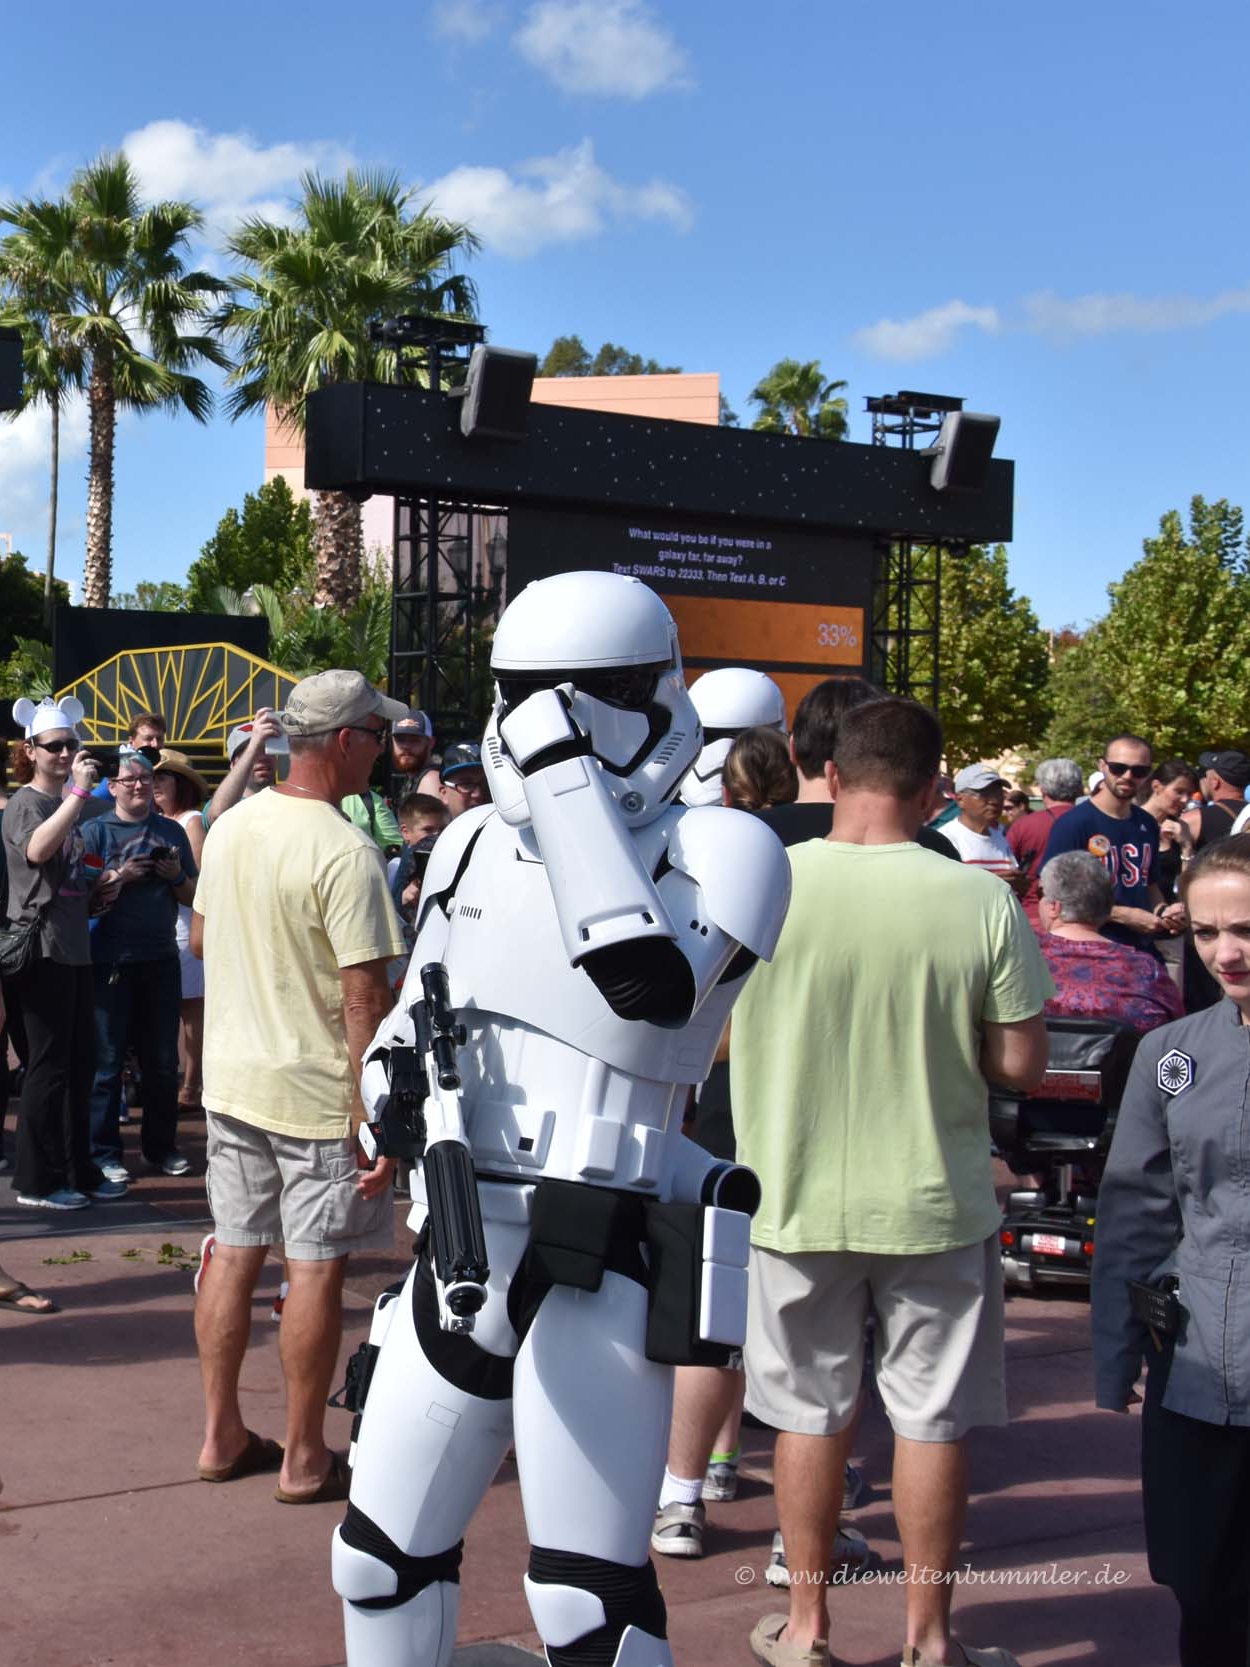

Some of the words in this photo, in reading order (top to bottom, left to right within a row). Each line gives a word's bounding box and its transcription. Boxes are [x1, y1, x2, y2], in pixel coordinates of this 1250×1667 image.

[629, 527, 652, 540] What
[652, 531, 679, 542] would
[680, 534, 697, 545] you
[697, 533, 709, 545] be
[717, 537, 734, 548] you
[735, 538, 755, 549] were
[755, 538, 765, 550] in
[765, 541, 772, 550] a
[658, 549, 687, 563] galaxy
[703, 551, 716, 563] far
[716, 554, 743, 567] away?
[613, 563, 631, 575] Text
[632, 564, 667, 577] SWARS
[667, 568, 677, 578] to
[707, 569, 728, 582] Then
[729, 571, 747, 584] Text
[768, 576, 778, 586] or
[779, 575, 787, 587] C
[817, 623, 857, 648] 33%
